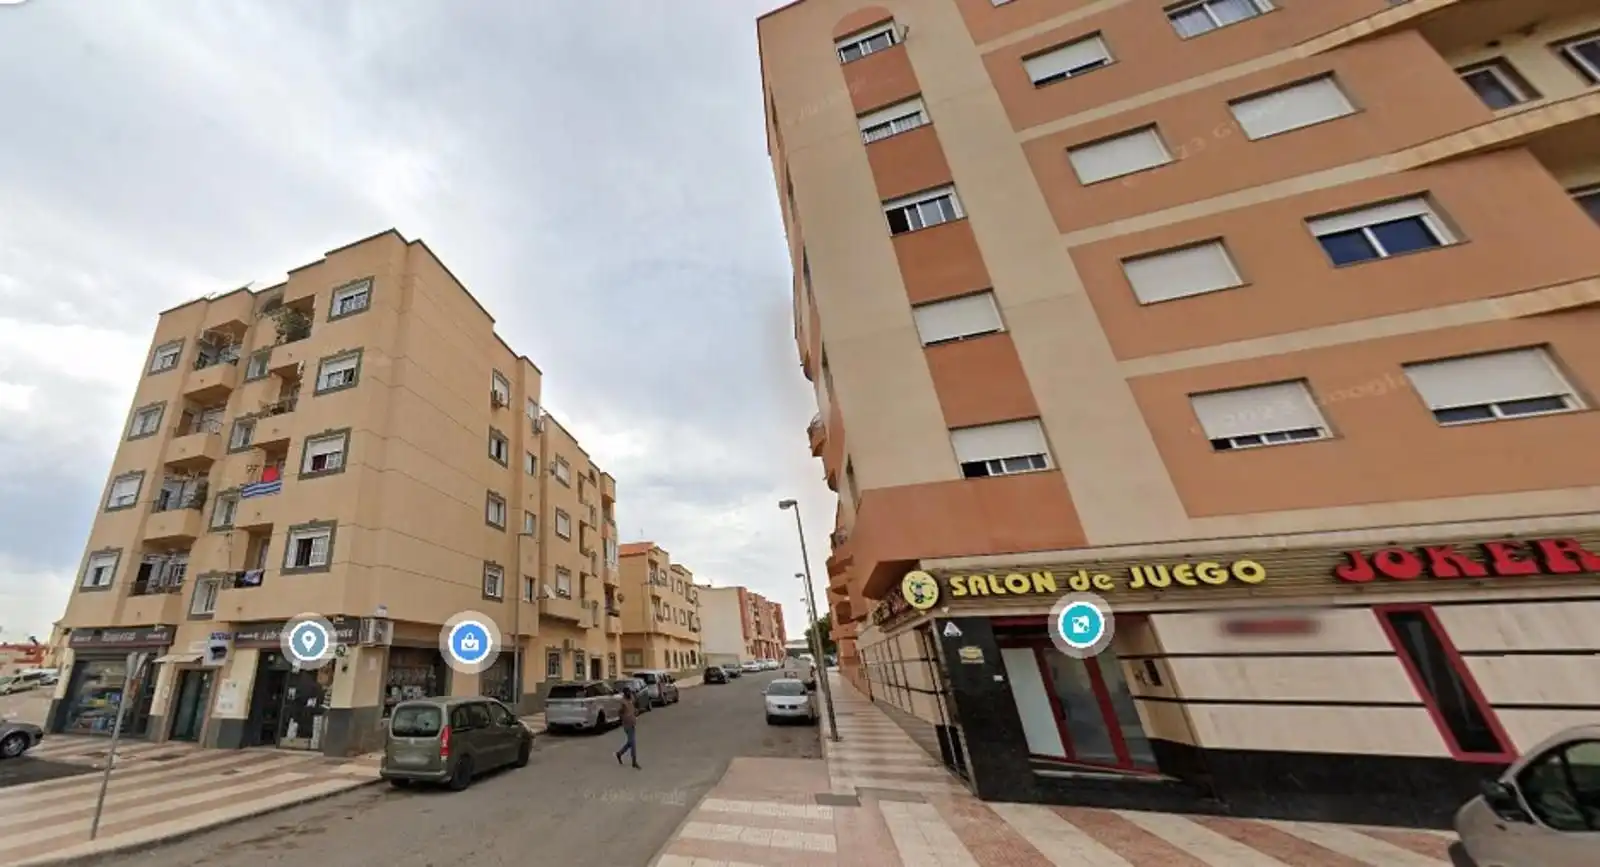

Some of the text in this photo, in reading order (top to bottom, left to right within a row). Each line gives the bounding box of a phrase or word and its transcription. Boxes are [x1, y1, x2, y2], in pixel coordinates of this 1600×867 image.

[949, 559, 1267, 597] SALON de JUEGO
[1334, 537, 1600, 584] JOKER
